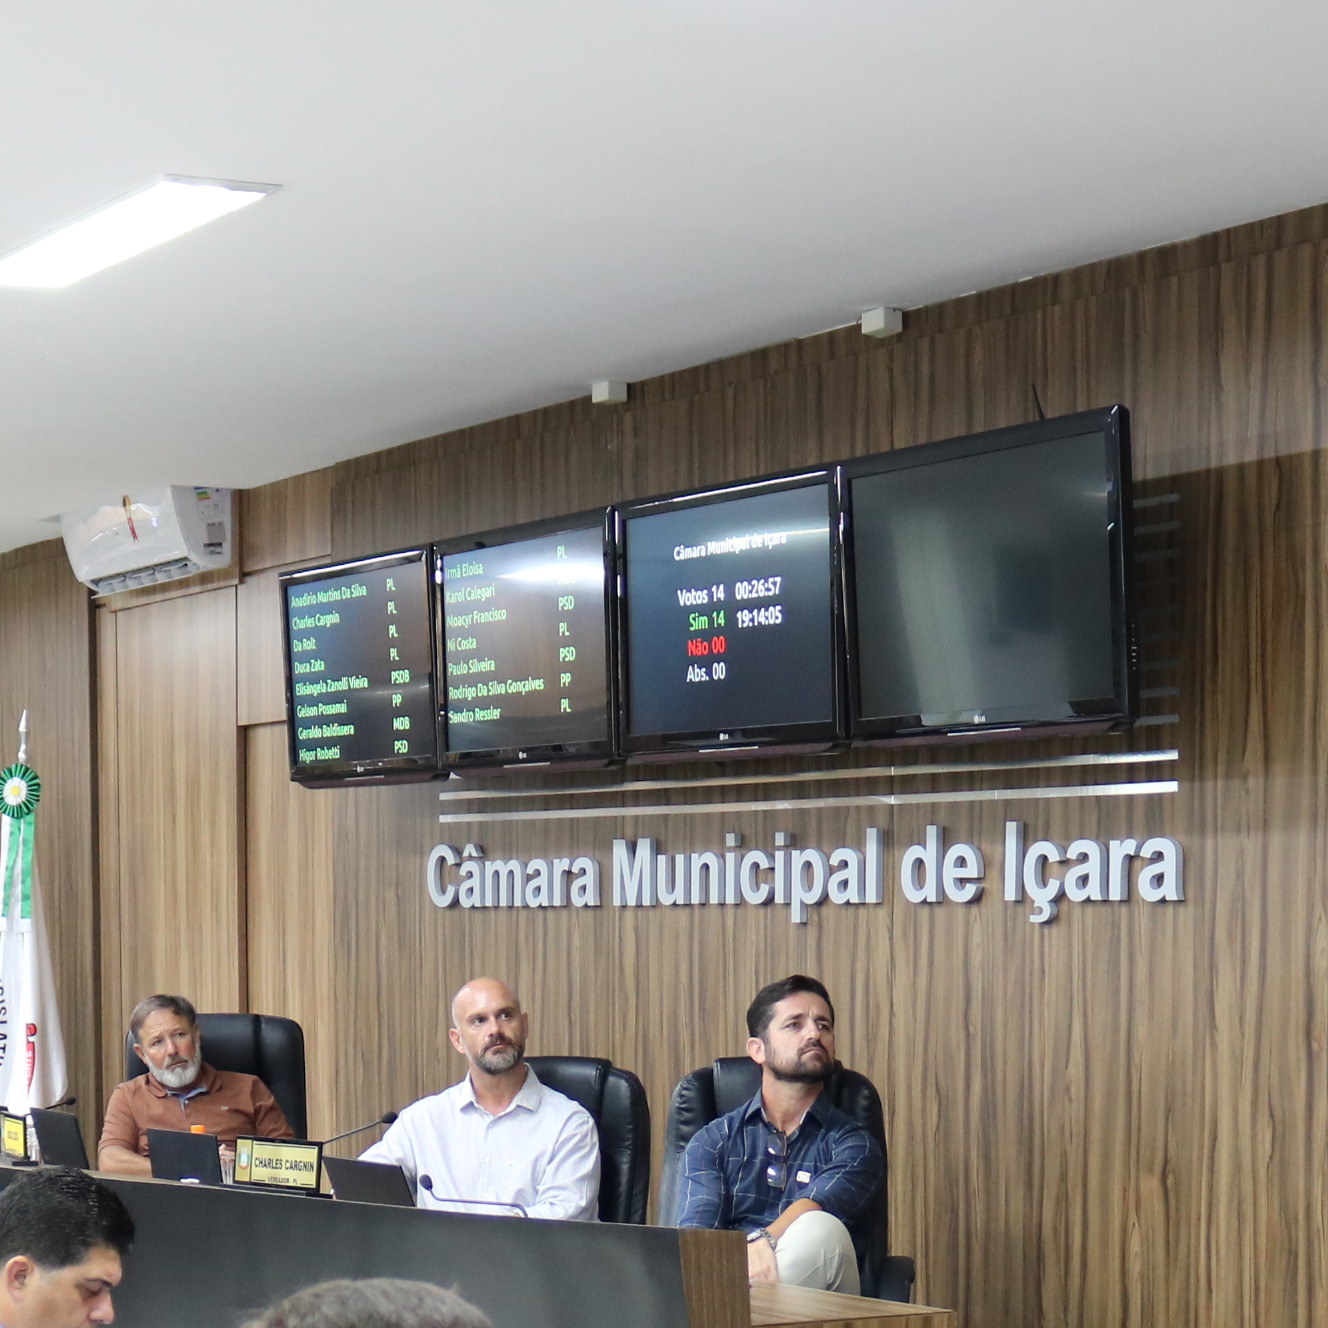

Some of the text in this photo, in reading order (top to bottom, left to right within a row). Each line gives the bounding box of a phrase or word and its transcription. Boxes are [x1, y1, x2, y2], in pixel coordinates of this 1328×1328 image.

[557, 545, 567, 560] PL
[673, 544, 706, 561] Câmara
[707, 534, 750, 556] Municipal
[386, 578, 396, 591] PL
[735, 576, 782, 601] 00:26:57
[317, 587, 341, 603] Martins
[341, 586, 351, 599] Da
[351, 583, 367, 598] Silva
[446, 582, 495, 604] Karol Calegari
[677, 583, 725, 607] Votos 14
[387, 601, 397, 615] PL
[558, 595, 575, 611] PSD
[292, 610, 340, 630] Charles Cargnin
[446, 607, 507, 629] Moacyr Francisco
[688, 609, 725, 631] Sim 14
[736, 605, 782, 628] 19:14:05
[388, 625, 398, 638] PL
[559, 622, 570, 637] PL
[293, 637, 316, 652] Da Rolt
[456, 636, 477, 651] Costa
[687, 636, 726, 656] Não 00
[389, 648, 399, 661] PL
[559, 646, 576, 662] PSD
[294, 661, 310, 674] Duca
[448, 657, 495, 676] Paulo Silveira
[686, 661, 726, 683] Abs. 00
[348, 675, 368, 690] Vieira
[391, 670, 410, 684] PSDB
[560, 672, 571, 687] PP
[449, 676, 544, 700] Rodrigo Da Silva Gonçalves
[392, 693, 402, 707] PP
[560, 698, 572, 713] PL
[297, 700, 347, 718] Gelson Possamai
[449, 705, 501, 724] Sandro Ressler
[298, 722, 354, 740] Geraldo Baldissera
[393, 716, 410, 731] MDB
[299, 745, 340, 763] Higor Robetti
[394, 740, 408, 754] PSD
[425, 820, 1186, 924] Câmara Municipal de Içara
[254, 1157, 315, 1173] CHARLES CARGNIN
[268, 1176, 290, 1185] VEREADOR
